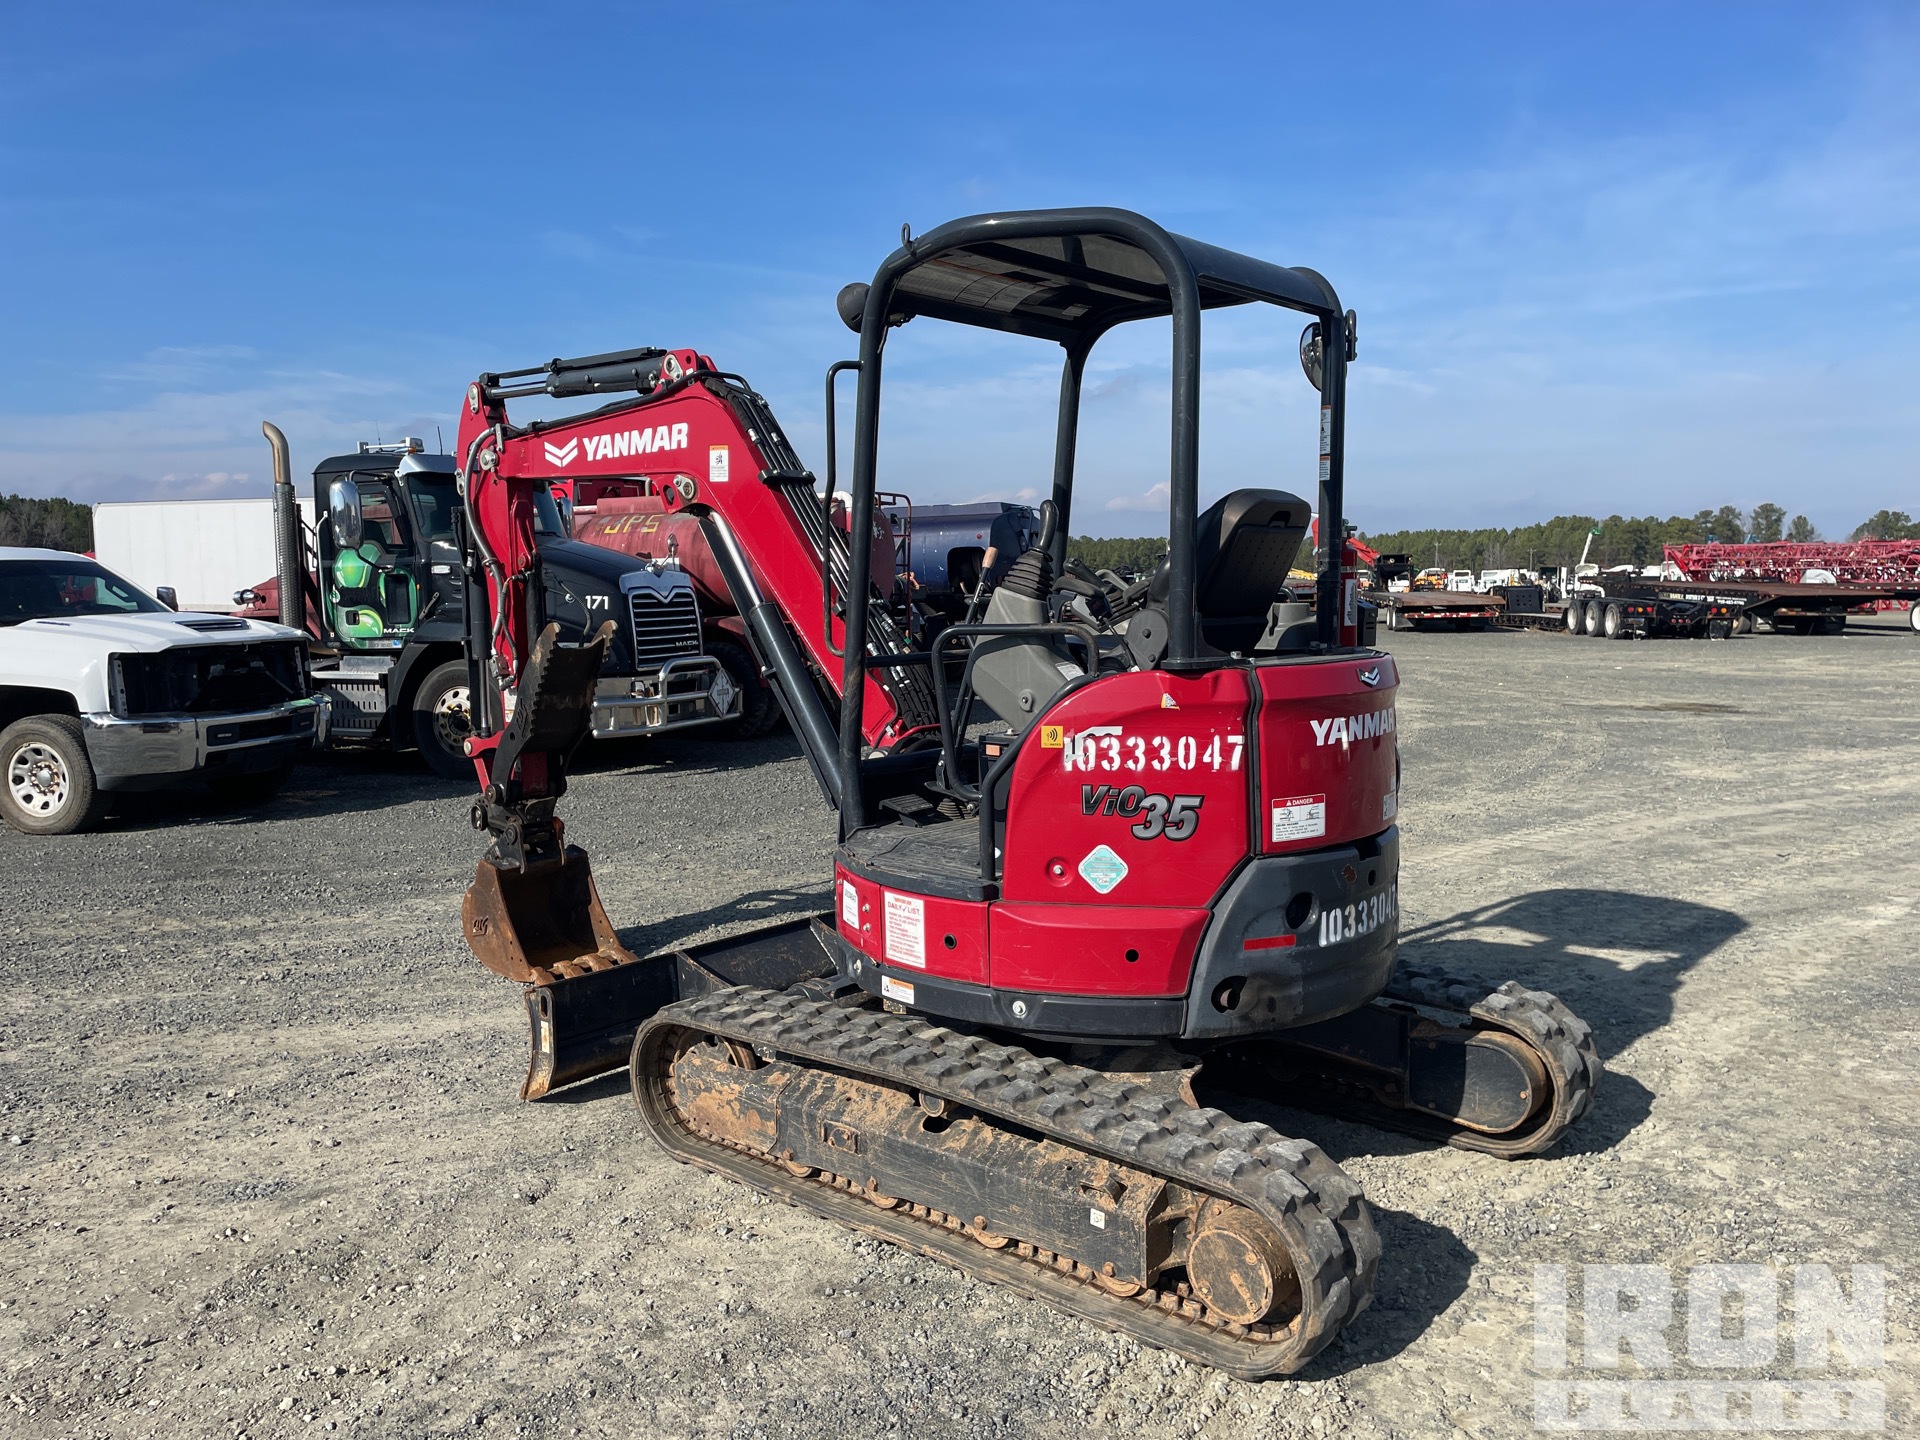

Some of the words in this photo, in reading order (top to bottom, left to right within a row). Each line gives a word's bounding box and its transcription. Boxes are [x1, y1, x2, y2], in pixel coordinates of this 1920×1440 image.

[582, 422, 689, 462] YANMAR
[603, 514, 665, 534] JPS
[585, 595, 609, 610] 171
[1063, 735, 1245, 772] 10333047
[1292, 798, 1314, 806] DANGER
[887, 901, 903, 912] DAILY
[907, 907, 920, 916] LIST
